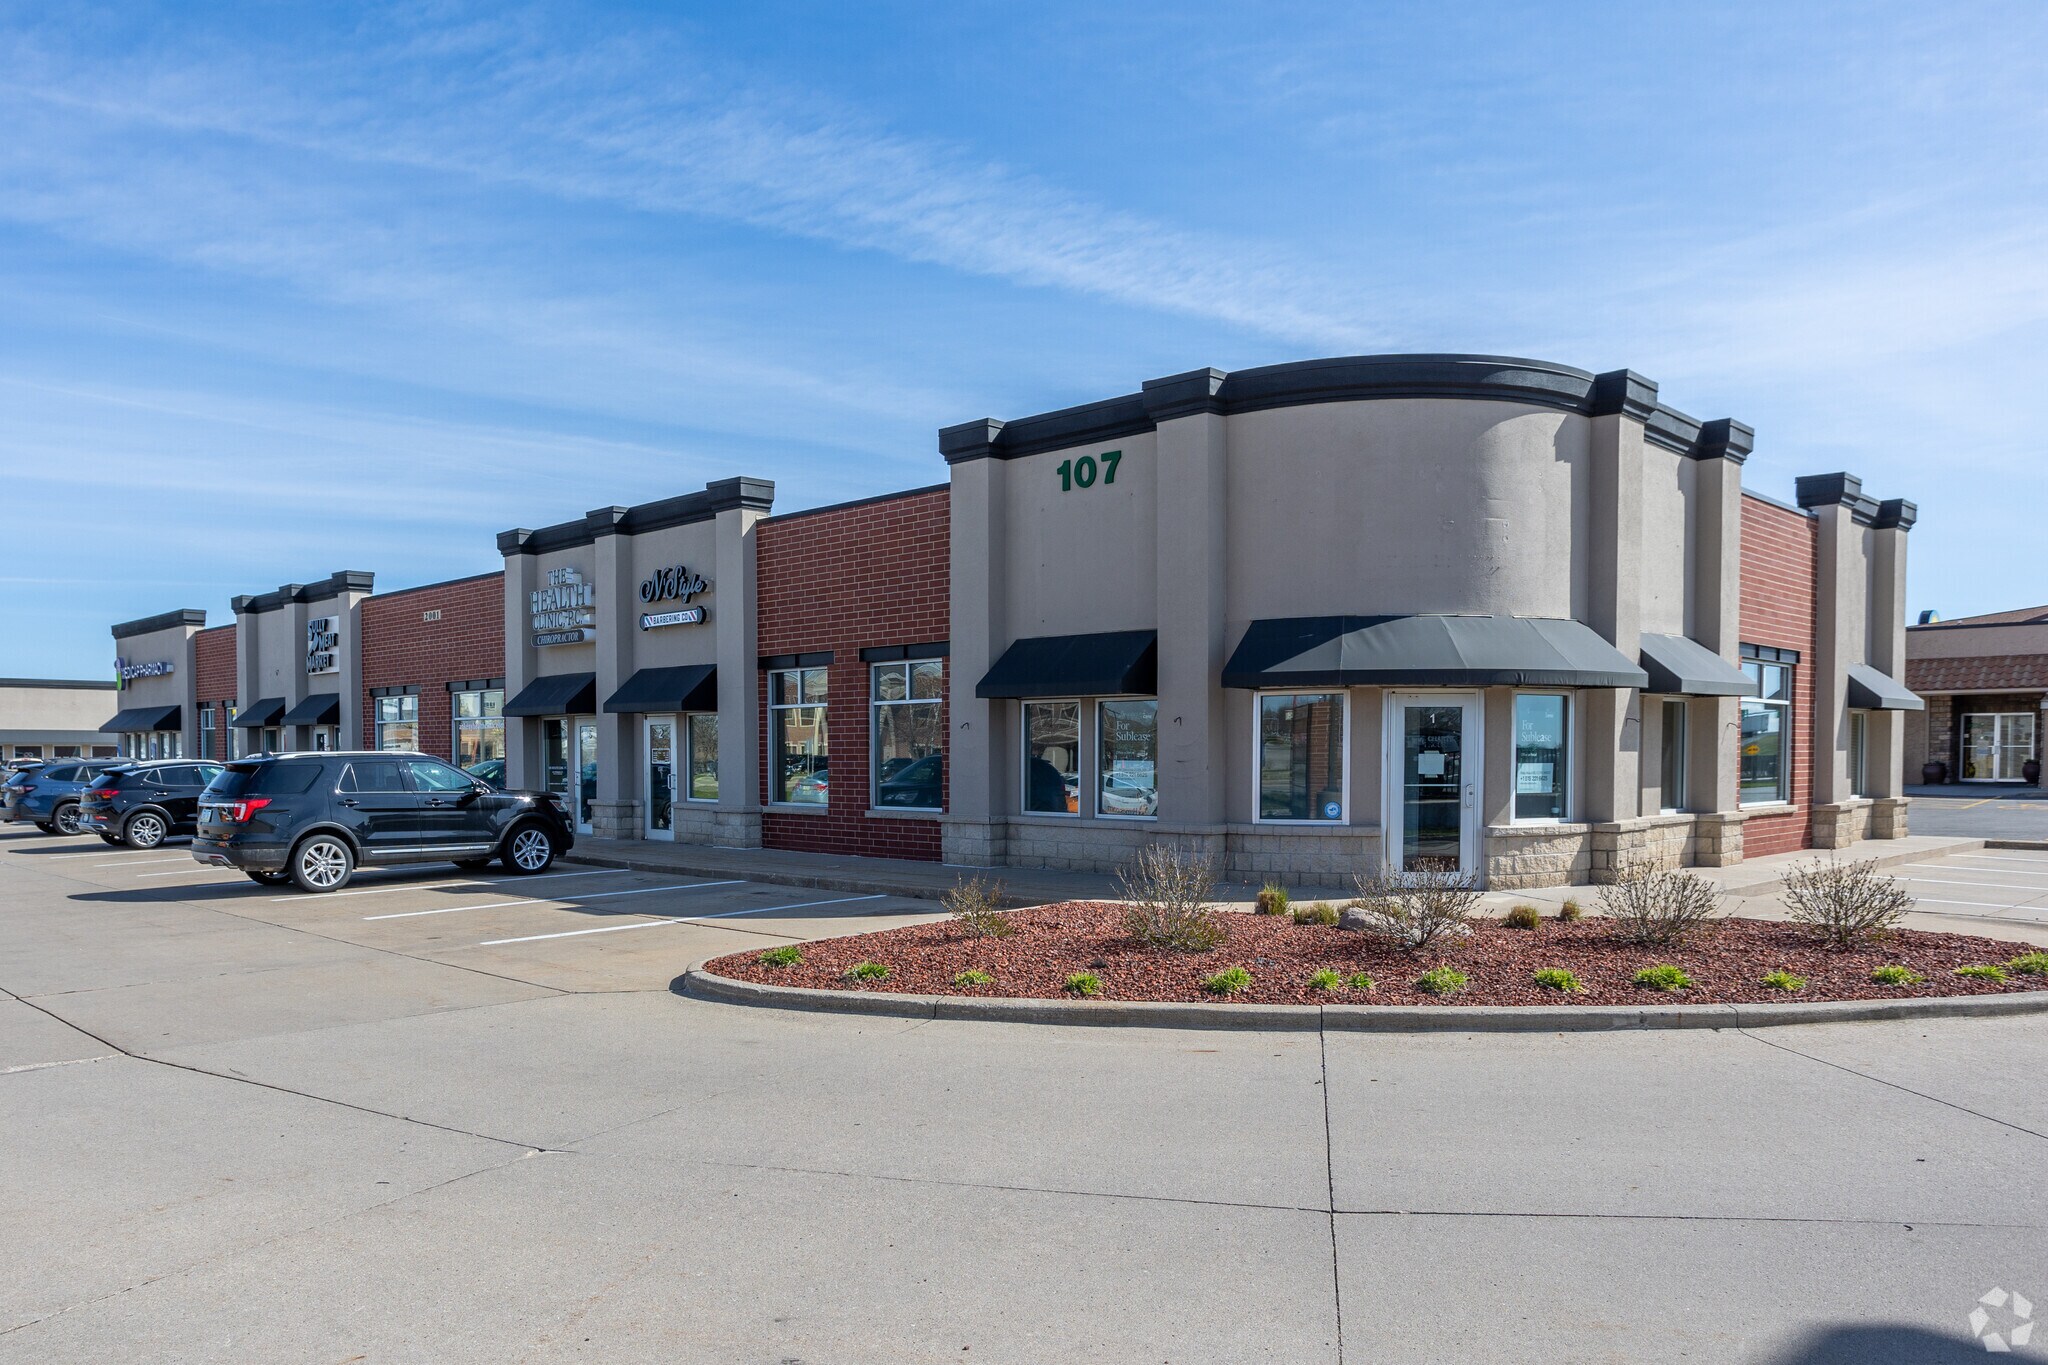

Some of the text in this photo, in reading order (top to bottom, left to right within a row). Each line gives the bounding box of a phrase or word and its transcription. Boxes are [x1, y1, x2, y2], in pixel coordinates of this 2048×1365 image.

[1056, 450, 1122, 492] 107
[547, 568, 567, 586] THE
[529, 583, 586, 614] HEALTH
[532, 611, 565, 631] CLINIC,
[653, 614, 681, 625] BARBERING
[307, 618, 327, 642] SULLY
[318, 633, 337, 652] MEAT
[537, 632, 579, 646] CHIROPRACTOR
[306, 654, 331, 673] MARKET
[1116, 720, 1130, 730] For
[1430, 713, 1435, 724] 1
[1522, 720, 1533, 730] For
[1116, 731, 1151, 741] Sublease
[1521, 731, 1552, 742] Sublease
